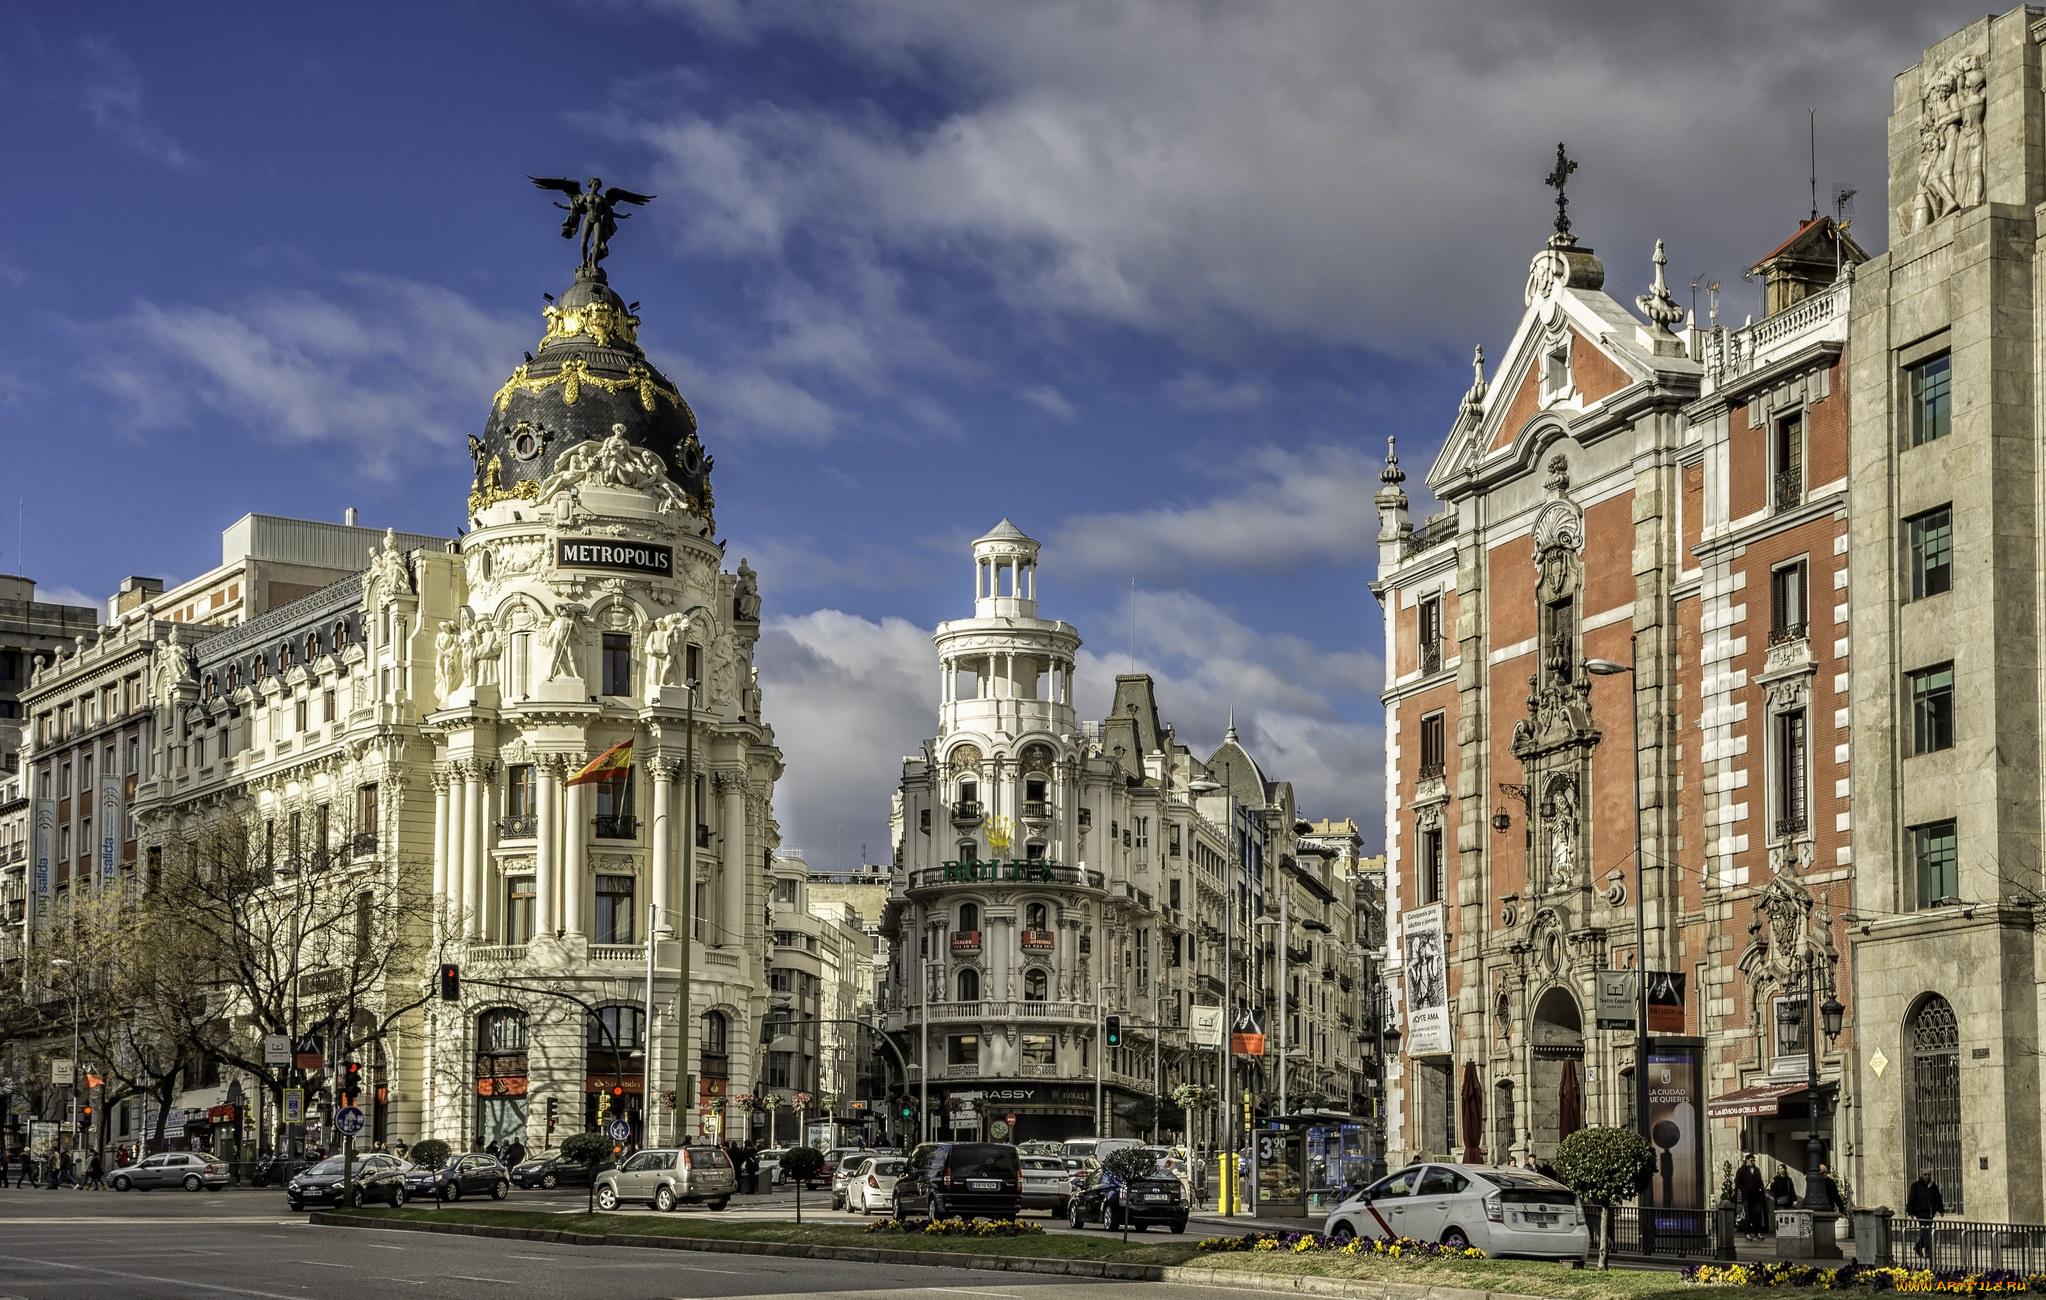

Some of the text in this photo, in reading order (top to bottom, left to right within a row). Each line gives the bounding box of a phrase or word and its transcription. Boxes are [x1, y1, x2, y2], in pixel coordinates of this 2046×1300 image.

[564, 545, 668, 568] METROPOLIS
[103, 838, 113, 874] salida
[37, 858, 48, 893] salida
[941, 857, 1058, 882] ROLEX
[37, 896, 50, 918] hay
[605, 1080, 641, 1088] Sanander
[980, 1090, 1035, 1099] RASSY
